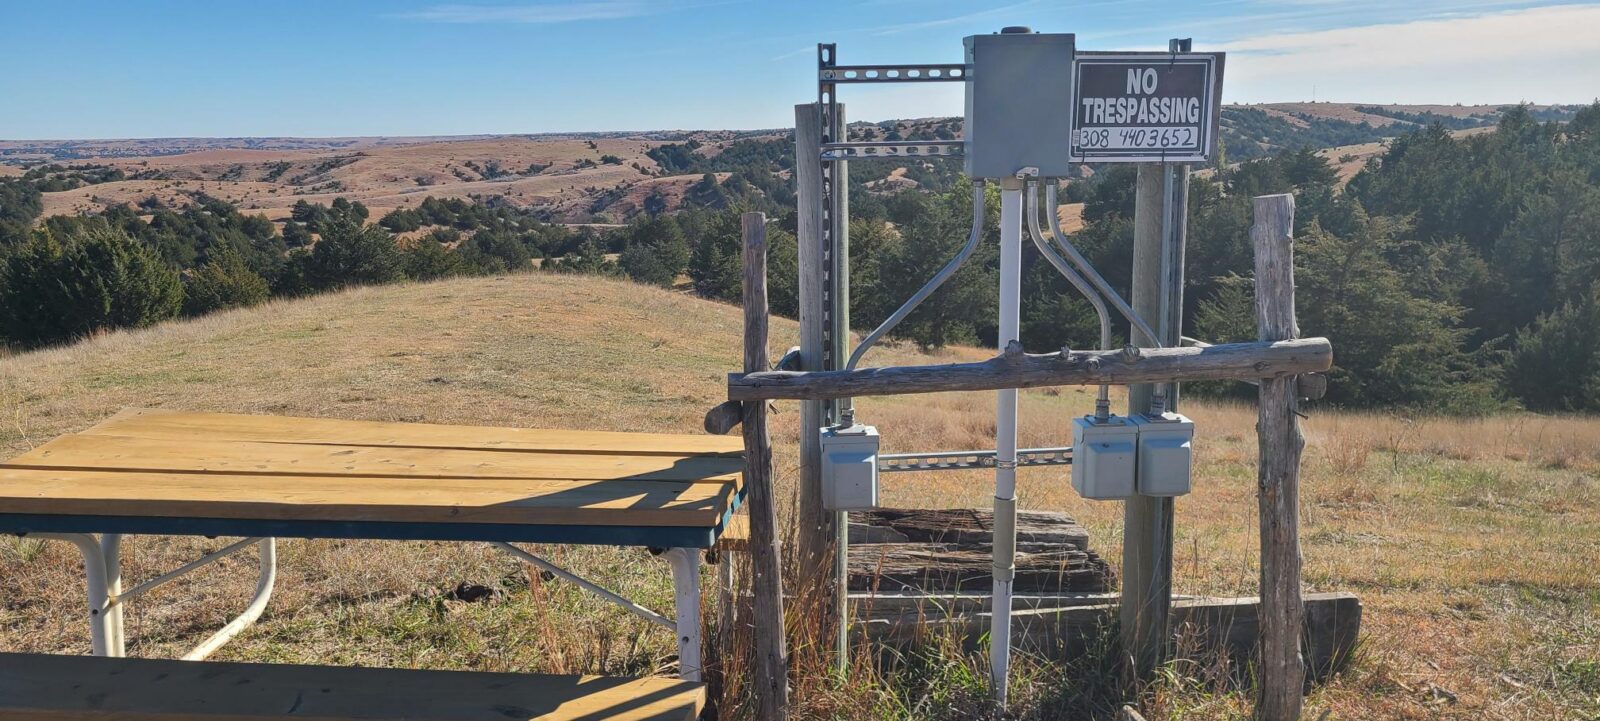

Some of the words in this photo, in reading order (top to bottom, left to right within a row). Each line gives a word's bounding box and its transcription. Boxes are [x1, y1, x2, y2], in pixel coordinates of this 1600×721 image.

[1126, 67, 1158, 95] NO
[1082, 97, 1200, 124] TRESPASSING
[1080, 129, 1110, 148] 308
